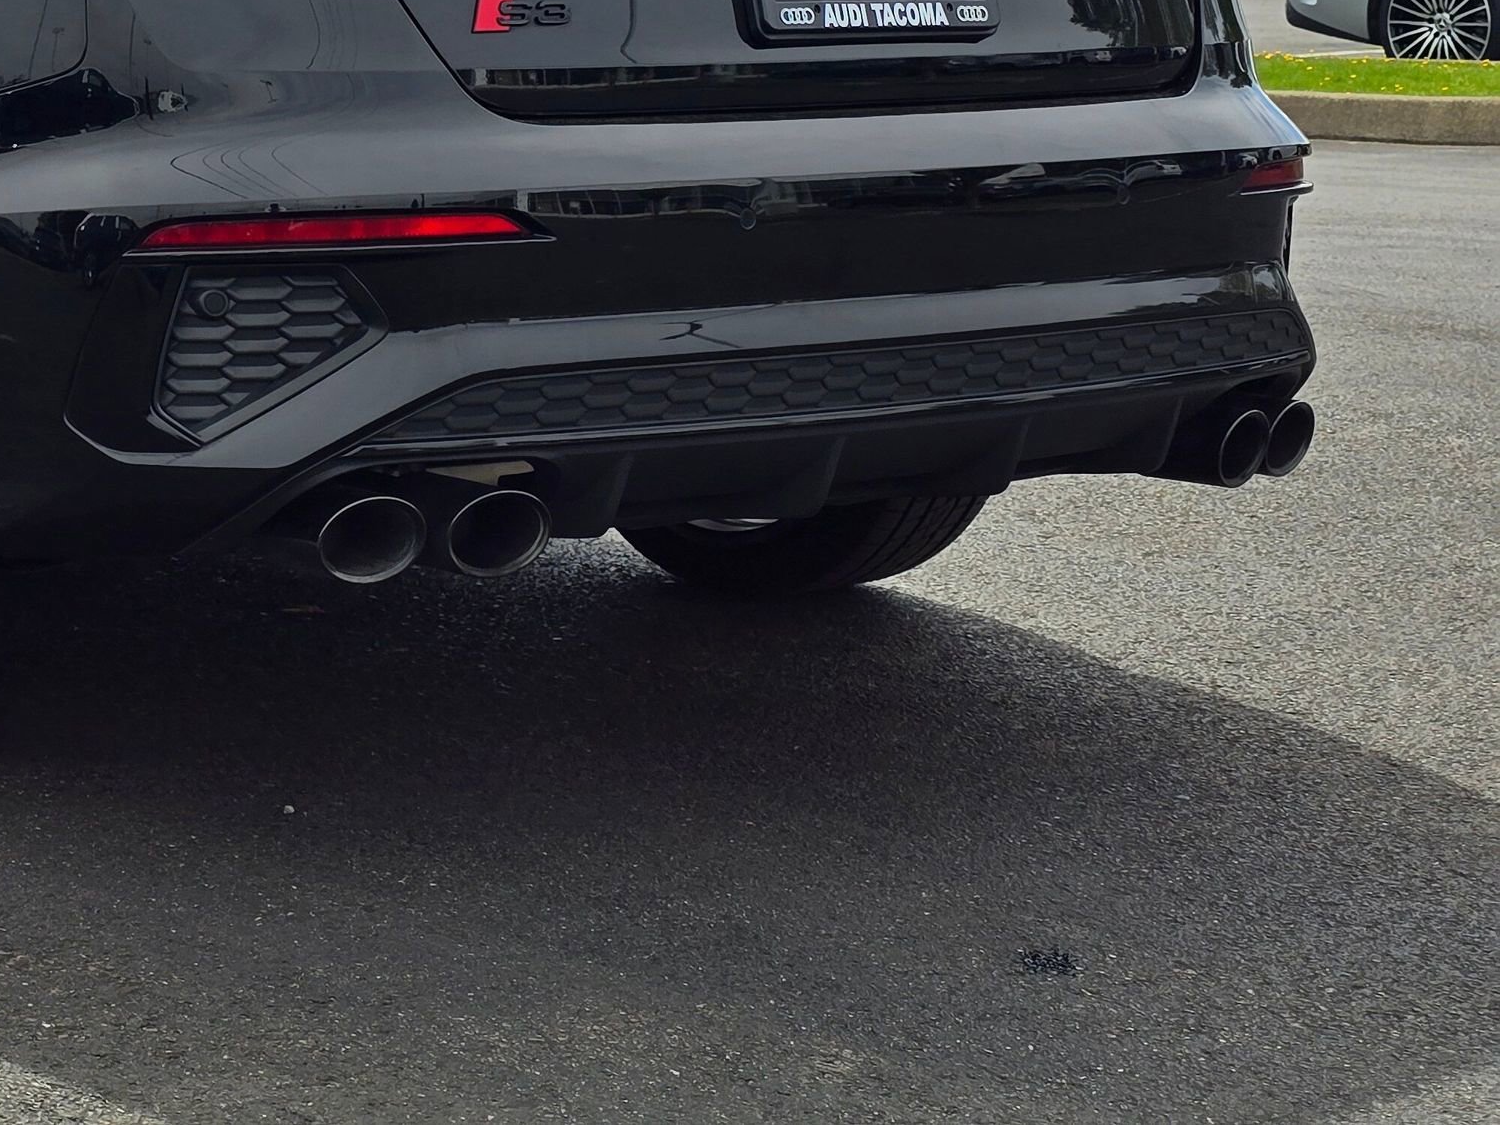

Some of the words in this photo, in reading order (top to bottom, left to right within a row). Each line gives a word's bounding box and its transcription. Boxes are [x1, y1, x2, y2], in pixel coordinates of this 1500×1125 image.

[496, 0, 572, 27] S3
[824, 3, 869, 28] AUDI
[871, 2, 950, 27] TACOMA
